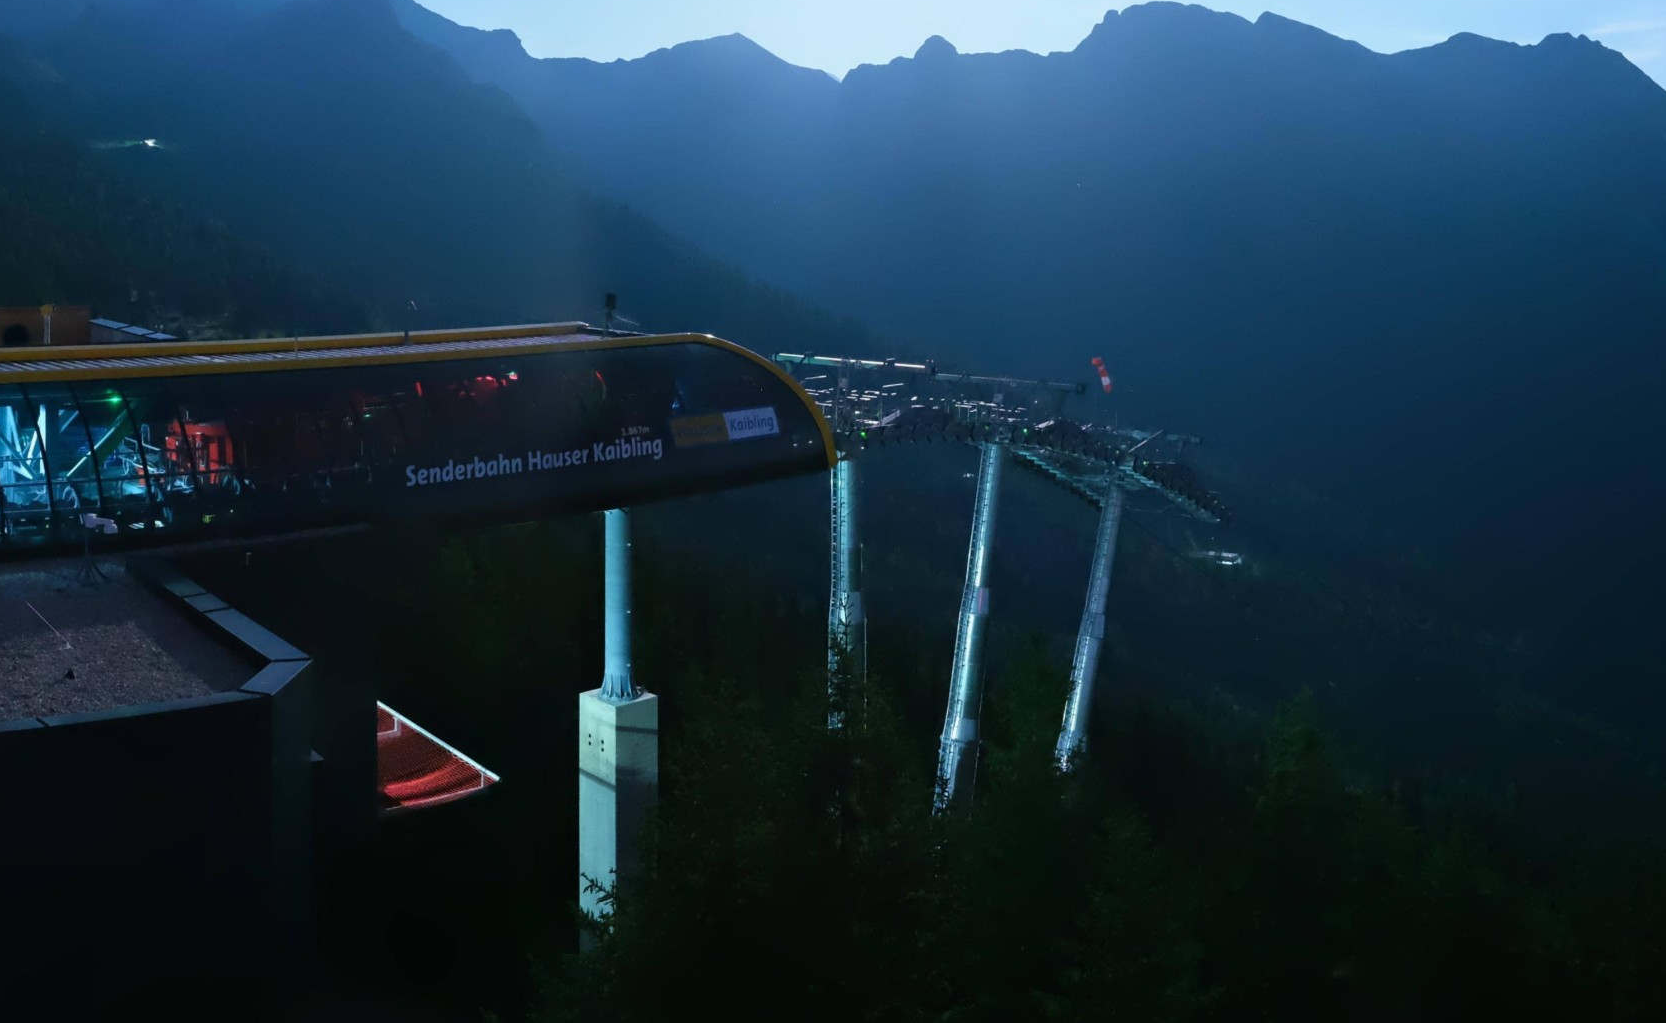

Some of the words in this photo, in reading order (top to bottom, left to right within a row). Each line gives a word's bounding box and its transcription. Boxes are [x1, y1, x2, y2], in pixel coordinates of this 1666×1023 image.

[729, 414, 775, 432] Kaibling
[405, 453, 523, 487] Senderbahn
[528, 447, 589, 472] Hauser
[592, 436, 663, 462] Kaibling
